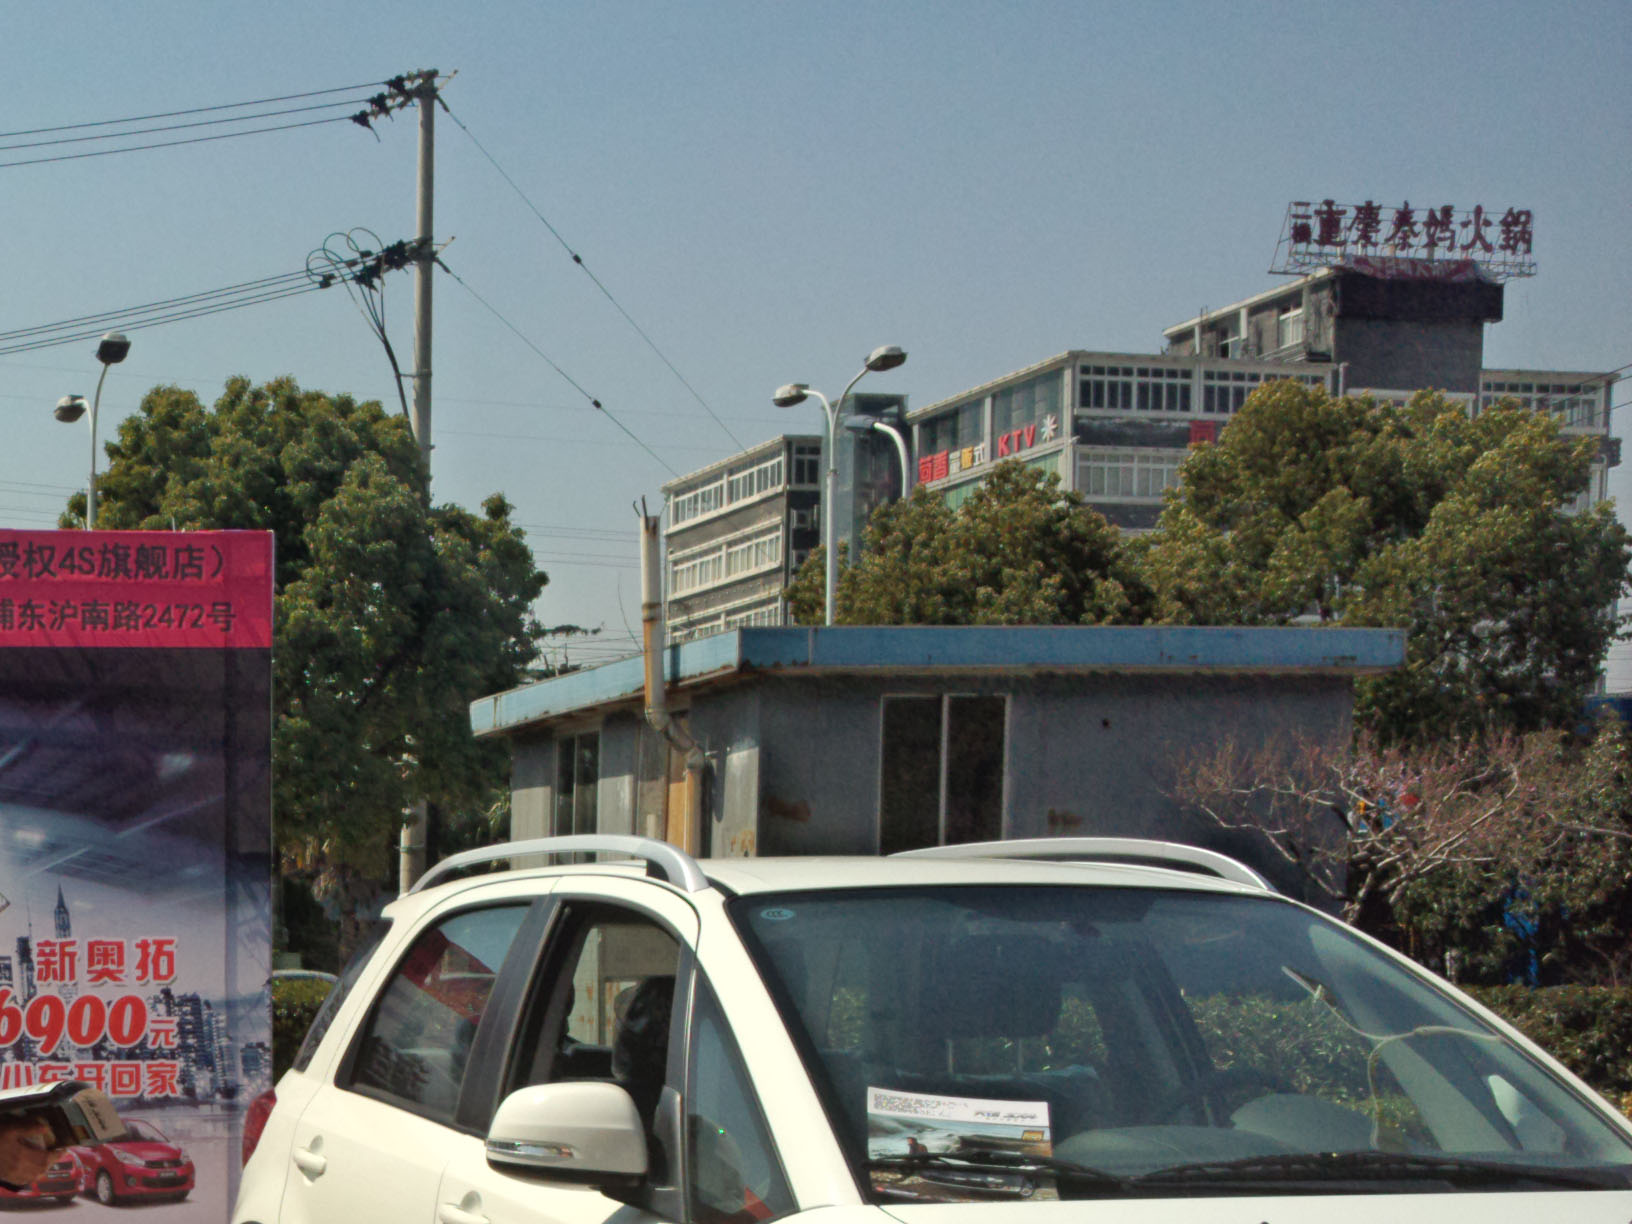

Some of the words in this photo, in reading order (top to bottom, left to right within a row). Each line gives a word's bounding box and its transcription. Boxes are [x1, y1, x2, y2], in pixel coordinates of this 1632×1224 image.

[997, 424, 1036, 457] KTV
[36, 939, 176, 983] 新奥拓
